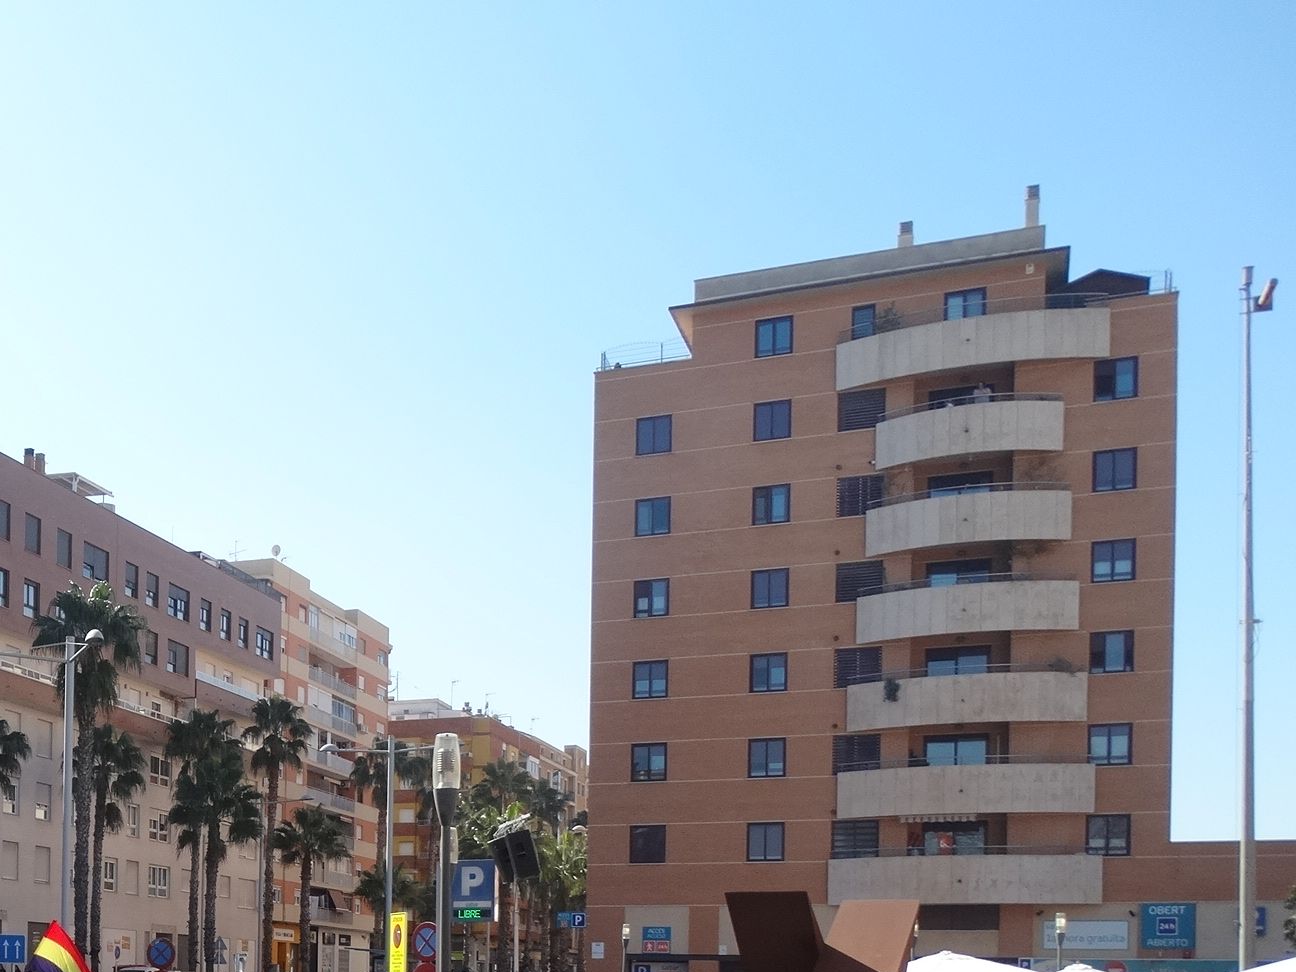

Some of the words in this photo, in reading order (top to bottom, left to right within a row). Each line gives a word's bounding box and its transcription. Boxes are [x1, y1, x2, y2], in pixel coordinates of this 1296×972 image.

[461, 866, 484, 896] P
[458, 909, 481, 918] LIBRE
[1148, 905, 1186, 915] OBERT
[1086, 933, 1126, 945] gratuita
[1147, 938, 1189, 947] ABIERTO
